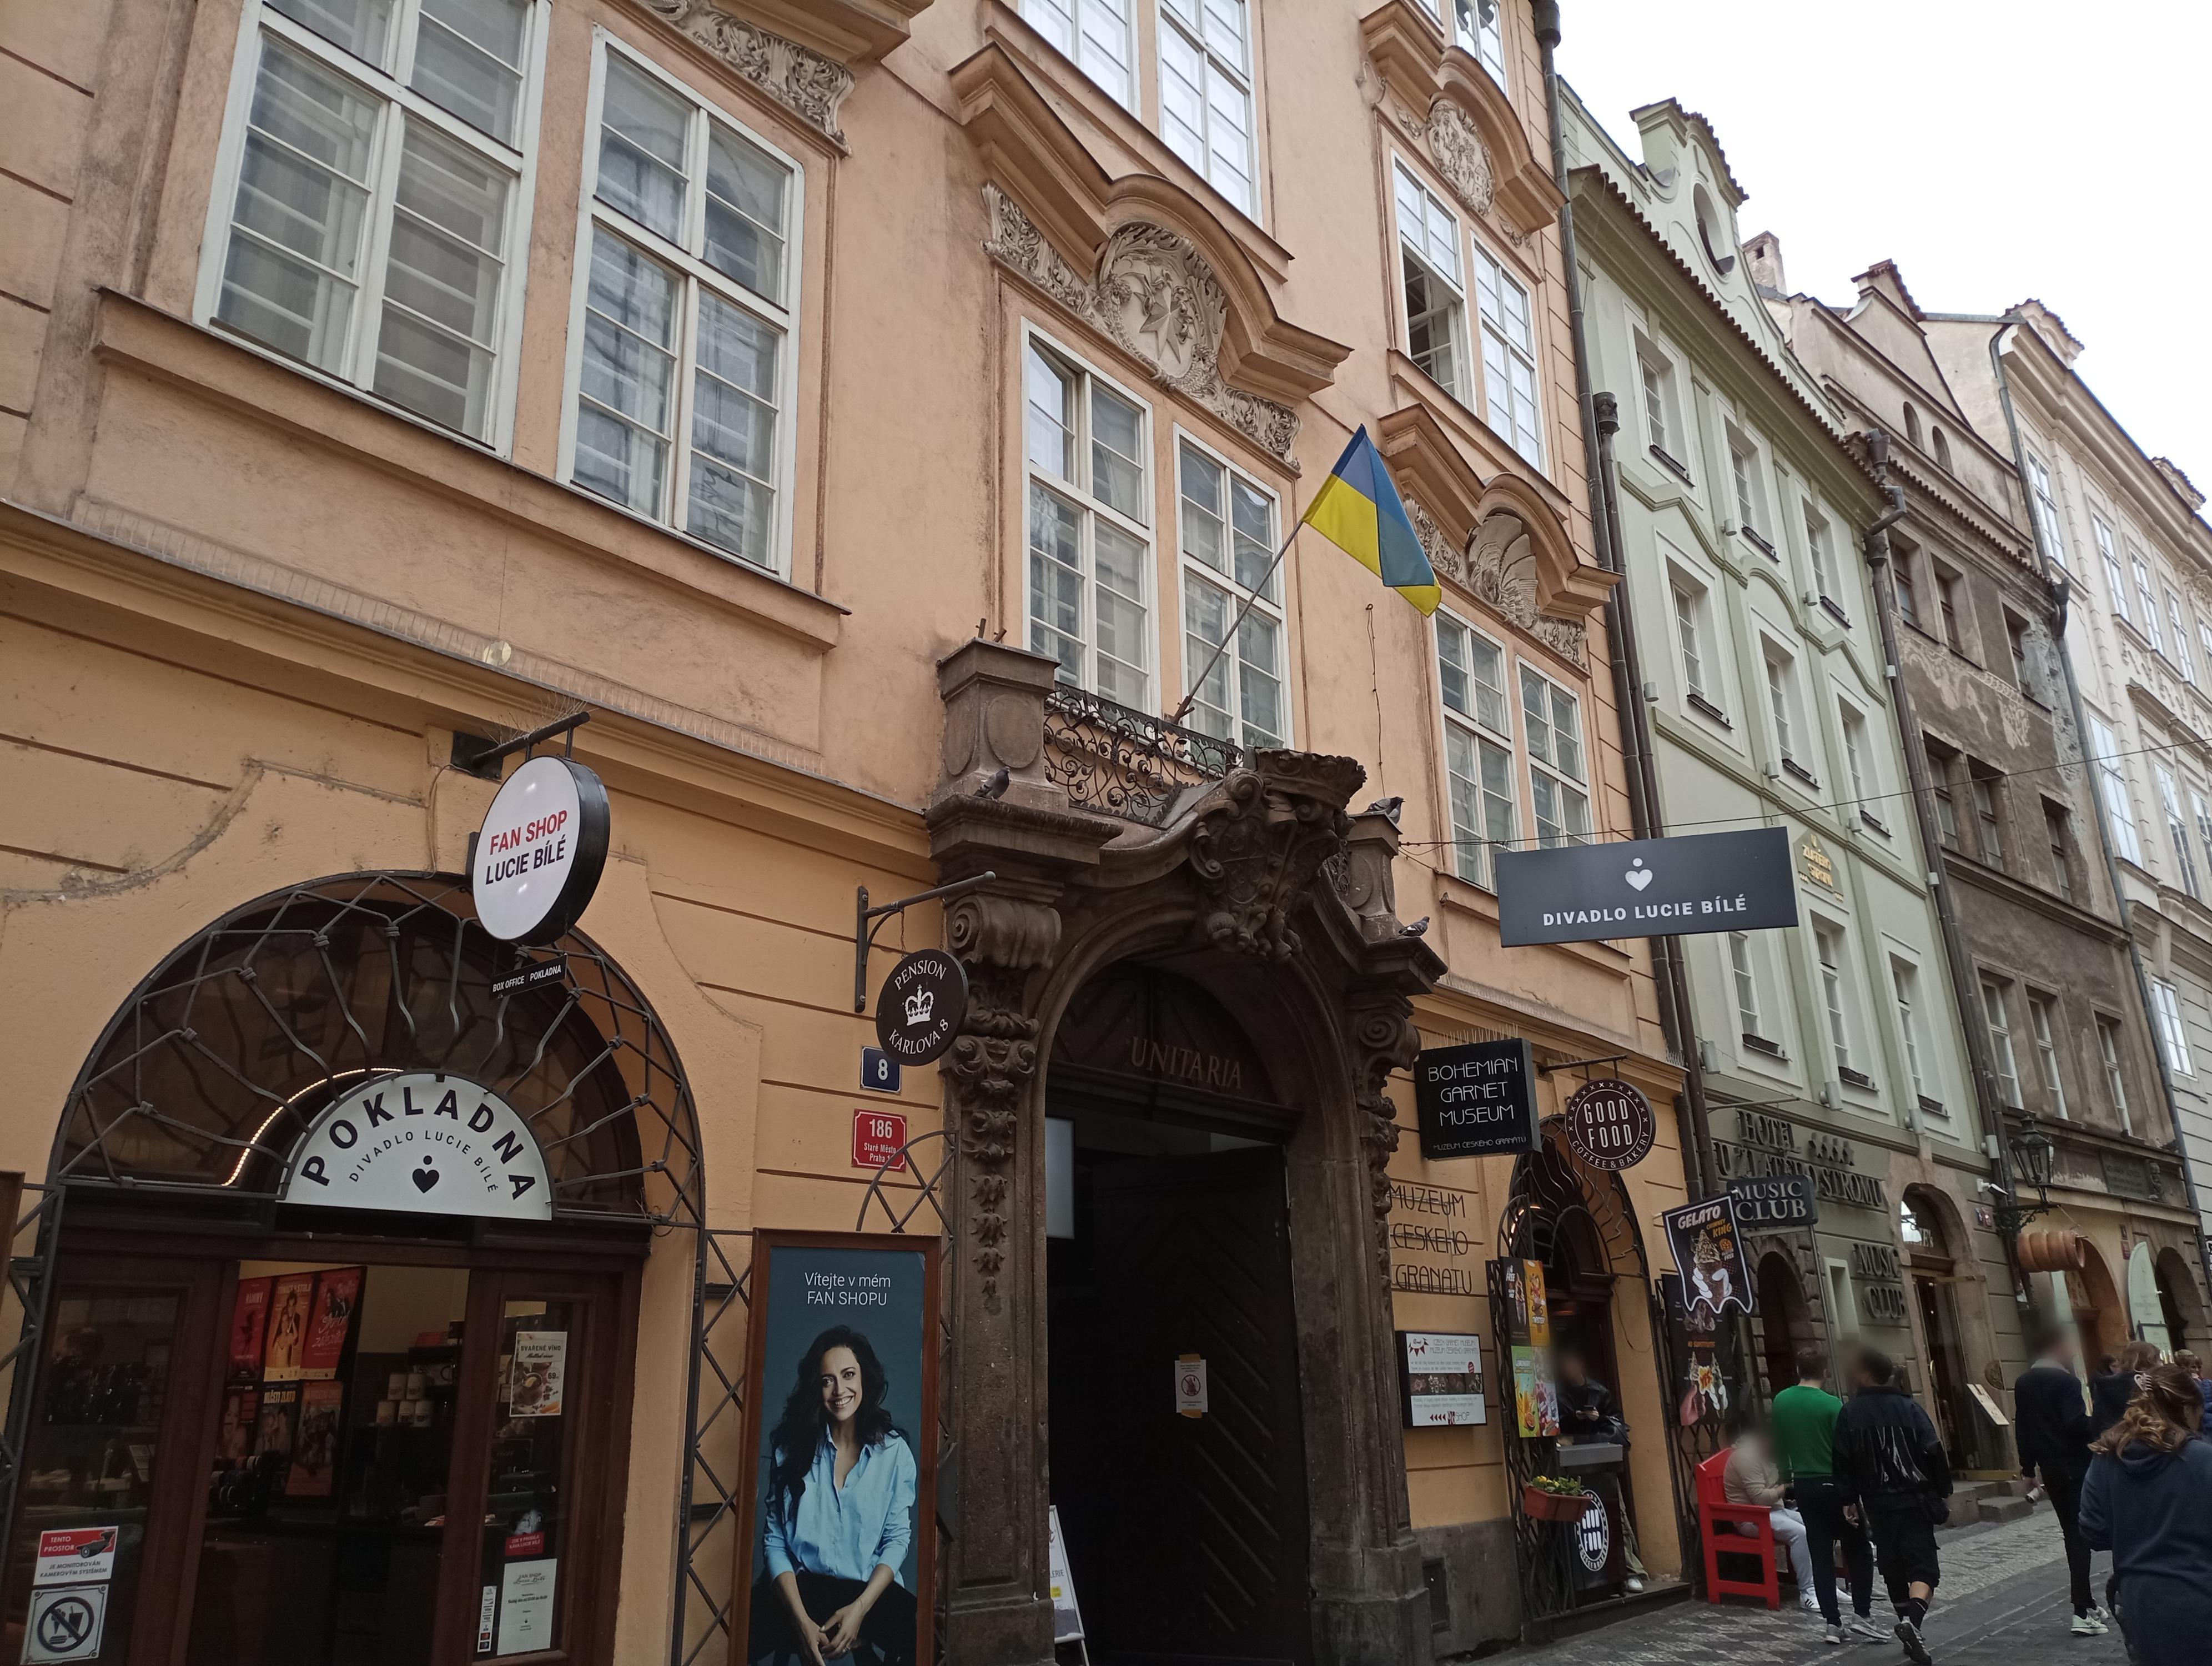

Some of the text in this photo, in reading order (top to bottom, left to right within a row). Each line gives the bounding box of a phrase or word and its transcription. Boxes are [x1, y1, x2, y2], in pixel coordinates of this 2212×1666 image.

[490, 810, 567, 855] FAN SHOP
[486, 834, 566, 885] LUCIE BÍLÉ
[1543, 894, 1747, 926] DIVADLO LUCIE BÍLÉ
[492, 975, 525, 992] BOX OFFICE
[530, 965, 561, 981] POKLADNA
[894, 960, 947, 991] PENSION
[889, 1018, 948, 1055] KARLOVA 8
[877, 1058, 888, 1081] 8
[1130, 1036, 1243, 1089] UNITARIA
[1428, 1057, 1518, 1082] BOHEMIAN
[1440, 1081, 1509, 1103] GARNET
[1440, 1104, 1514, 1127] MUSEUM
[1583, 1099, 1628, 1124] GOOD
[869, 1118, 893, 1138] 186
[1588, 1124, 1632, 1149] FOOD
[1736, 1110, 1802, 1154] HOTEL
[300, 1086, 536, 1200] POKLADNA
[864, 1142, 896, 1154] Staré Město
[1434, 1142, 1461, 1151] MUZEUM
[1572, 1140, 1607, 1168] COFFEE
[1619, 1131, 1650, 1167] BAKERY
[349, 1130, 499, 1193] DIVADLO LUCIE BÍLÉ
[869, 1153, 886, 1162] Praha
[1735, 1181, 1803, 1201] MUSIC
[1820, 1168, 1884, 1206] STROMU
[1389, 1185, 1465, 1218] MUZEUM
[1736, 1198, 1807, 1221] CLUB
[1677, 1205, 1721, 1230] GELATO
[1712, 1222, 1732, 1238] KING
[1853, 1243, 1901, 1278] MUSIC
[805, 1272, 891, 1289] Vítejte v mém
[807, 1291, 887, 1306] FAN SHOPU
[1865, 1286, 1905, 1319] CLUB
[1456, 1412, 1470, 1422] SHOP
[1583, 1530, 1602, 1552] FOOD
[39, 1567, 107, 1578] KAMEROVÝM SYSTÉMEM
[56, 1559, 100, 1569] MONITOROVÁN
